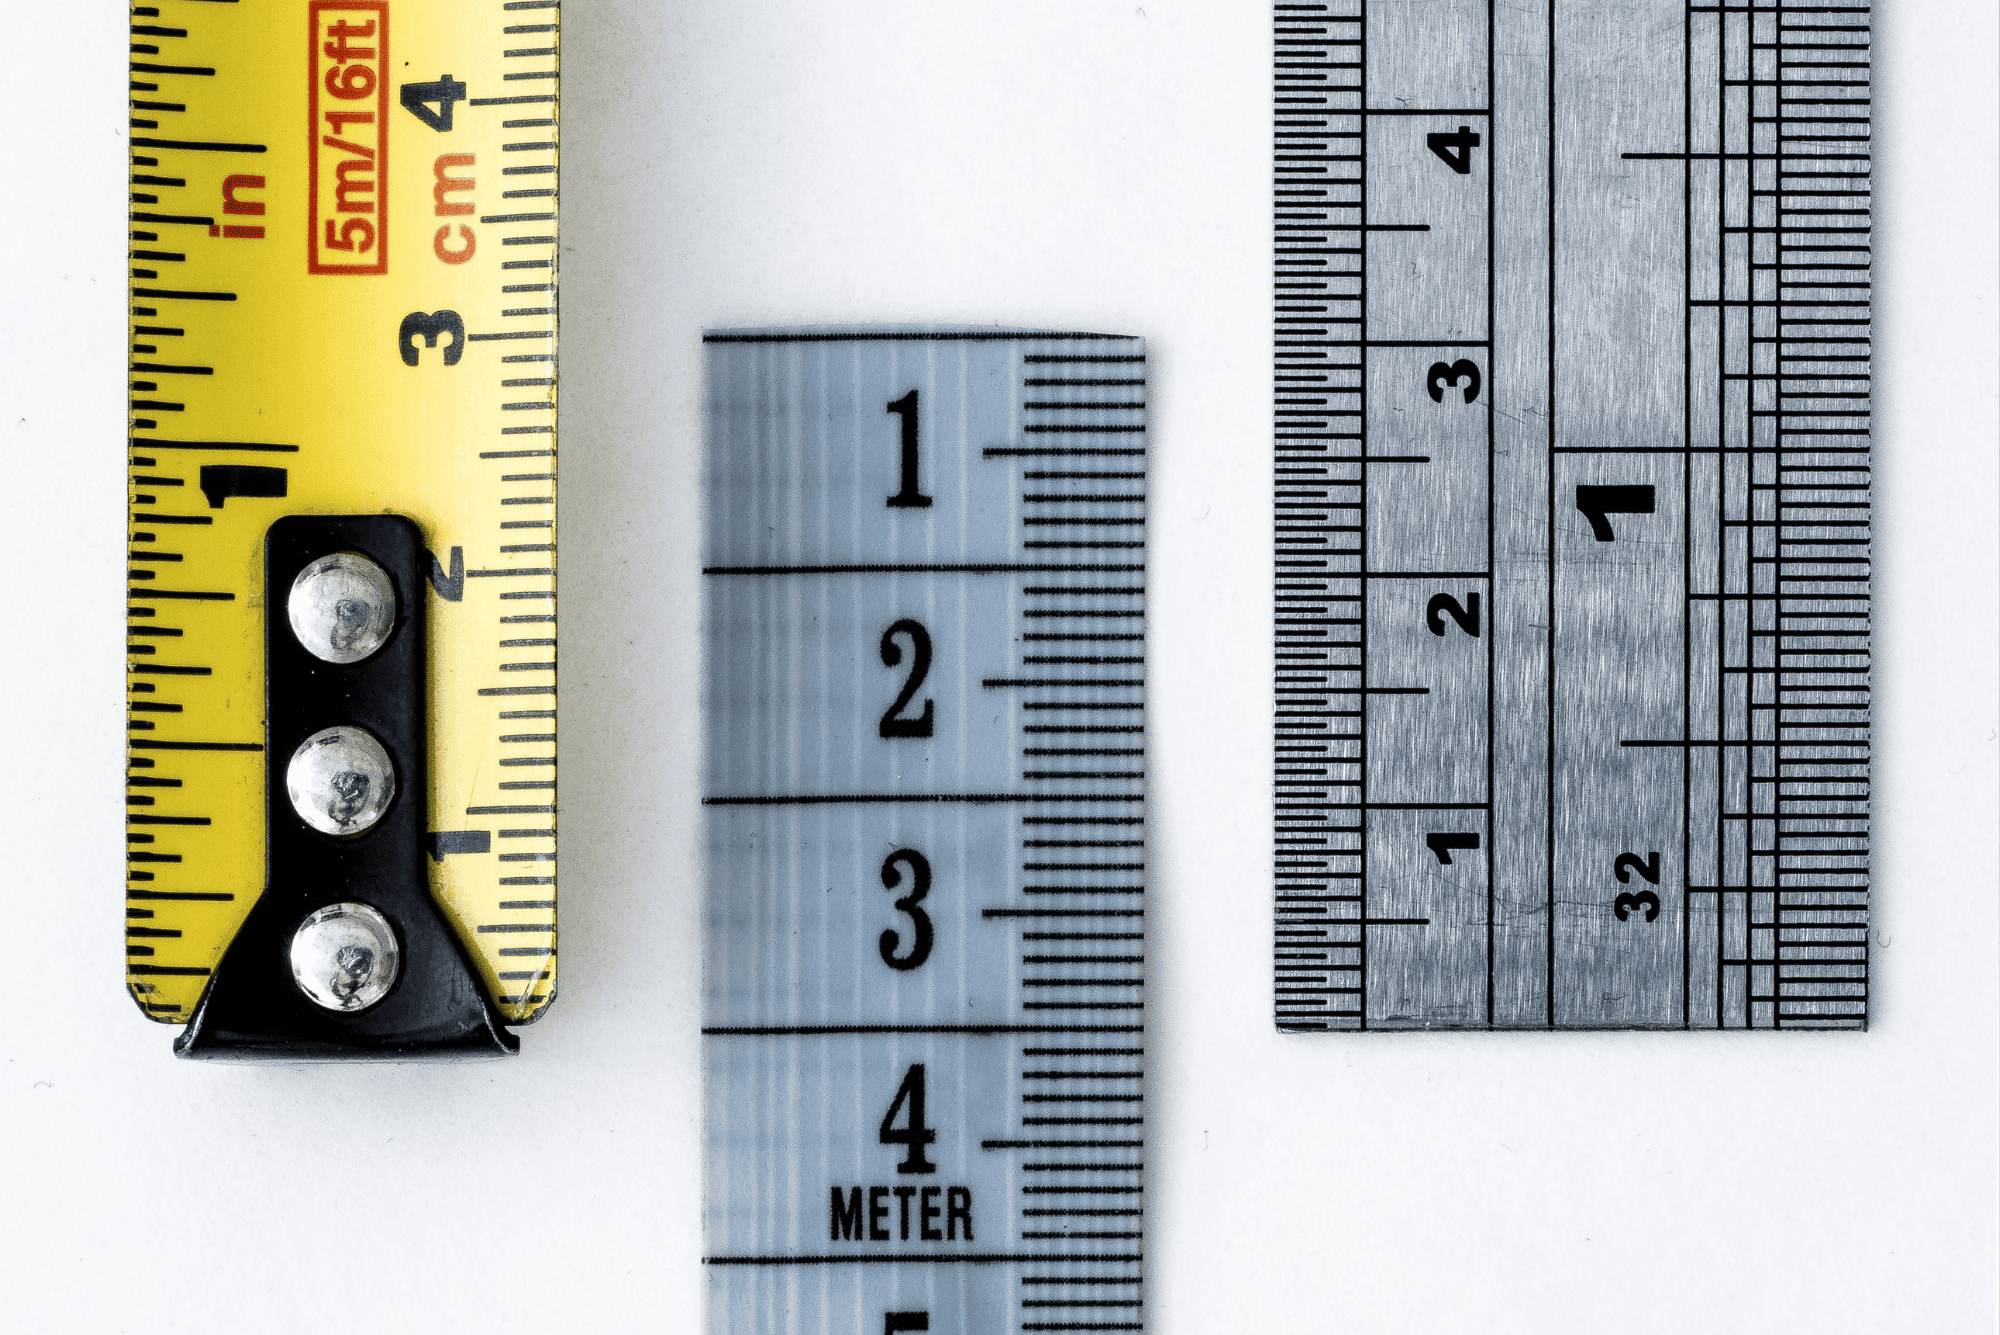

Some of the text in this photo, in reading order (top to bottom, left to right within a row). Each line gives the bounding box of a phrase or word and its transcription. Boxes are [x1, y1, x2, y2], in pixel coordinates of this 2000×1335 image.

[400, 74, 467, 132] 4
[323, 19, 376, 253] 5m/16ft
[1427, 126, 1480, 175] 4
[209, 174, 266, 239] in
[433, 152, 477, 264] cm
[399, 309, 465, 366] 3
[1427, 358, 1481, 405] 3
[886, 389, 933, 508] 1
[200, 464, 288, 509] 1
[1576, 484, 1655, 542] 1
[1427, 592, 1480, 637] 2
[879, 618, 934, 738] 2
[427, 831, 491, 862] 1
[1426, 832, 1480, 865] 1
[878, 848, 934, 971] 3
[1614, 851, 1661, 923] 32
[879, 1063, 936, 1174] 4
[830, 1185, 974, 1241] METER
